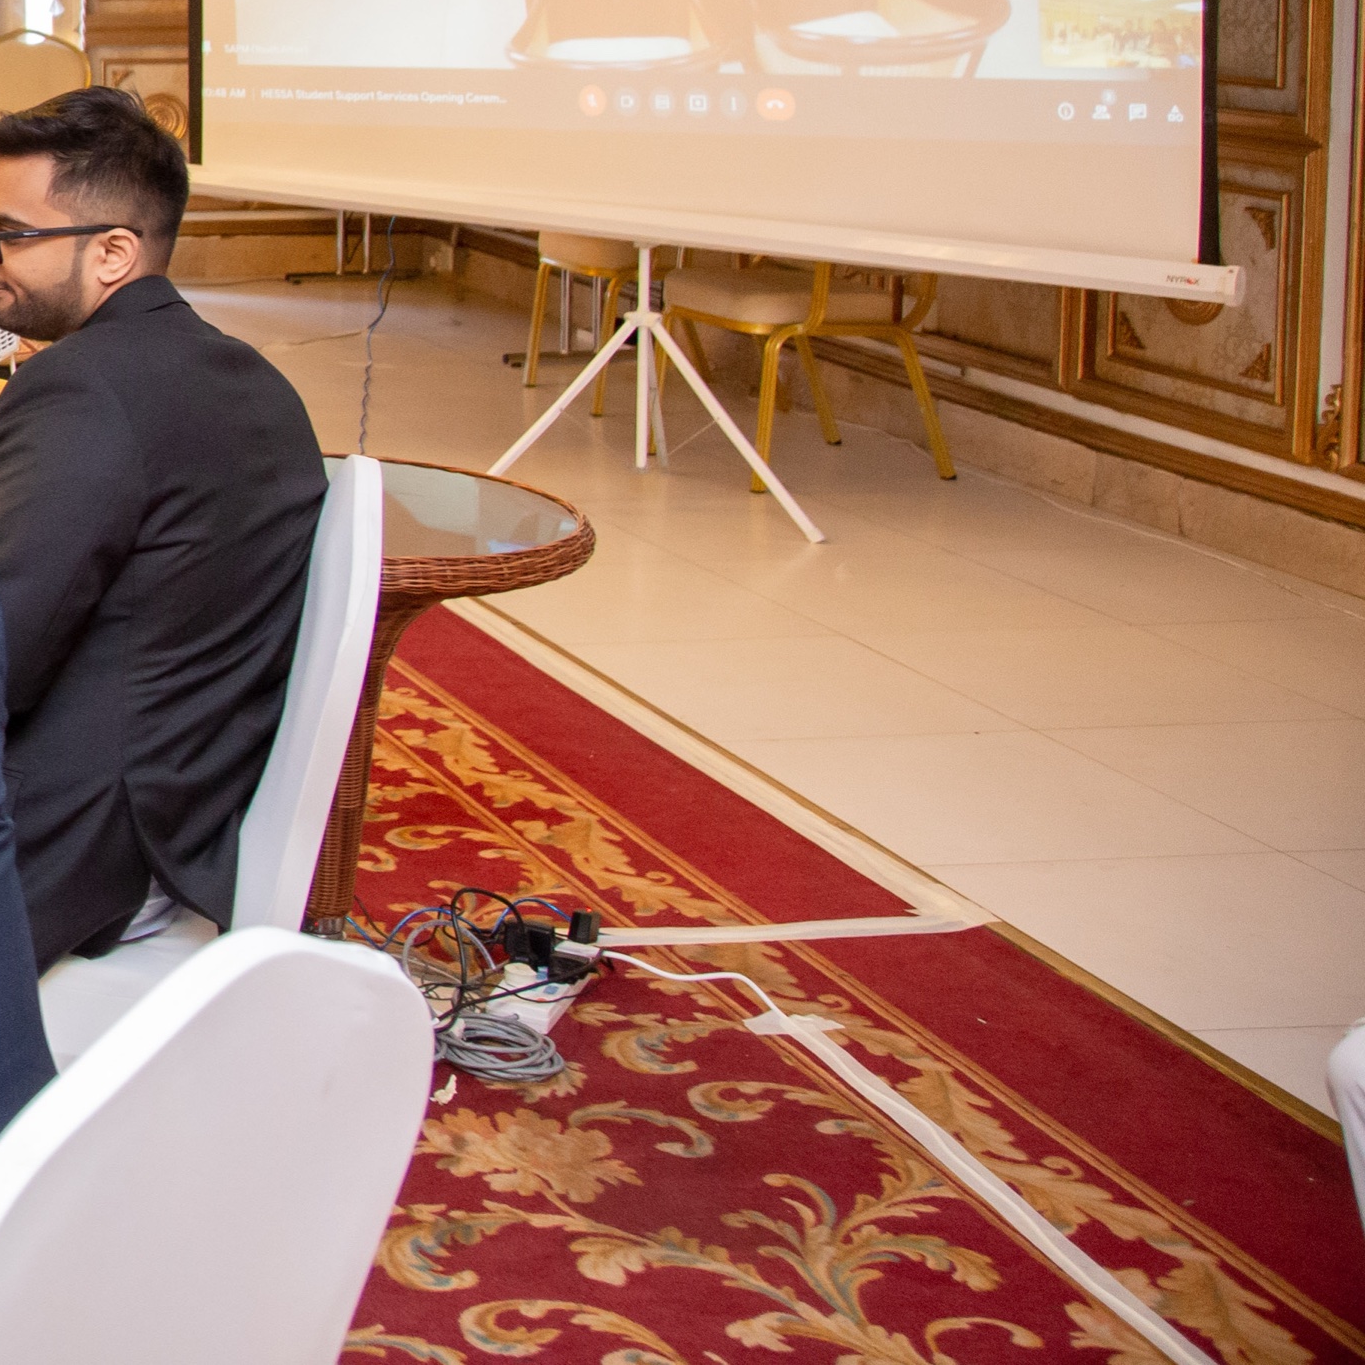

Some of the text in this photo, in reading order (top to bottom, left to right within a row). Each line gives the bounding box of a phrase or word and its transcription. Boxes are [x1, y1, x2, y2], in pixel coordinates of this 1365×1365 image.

[229, 88, 246, 98] AM
[295, 89, 334, 100] Student
[335, 90, 375, 103] Support
[376, 90, 419, 102] Services
[420, 90, 464, 106] Opening
